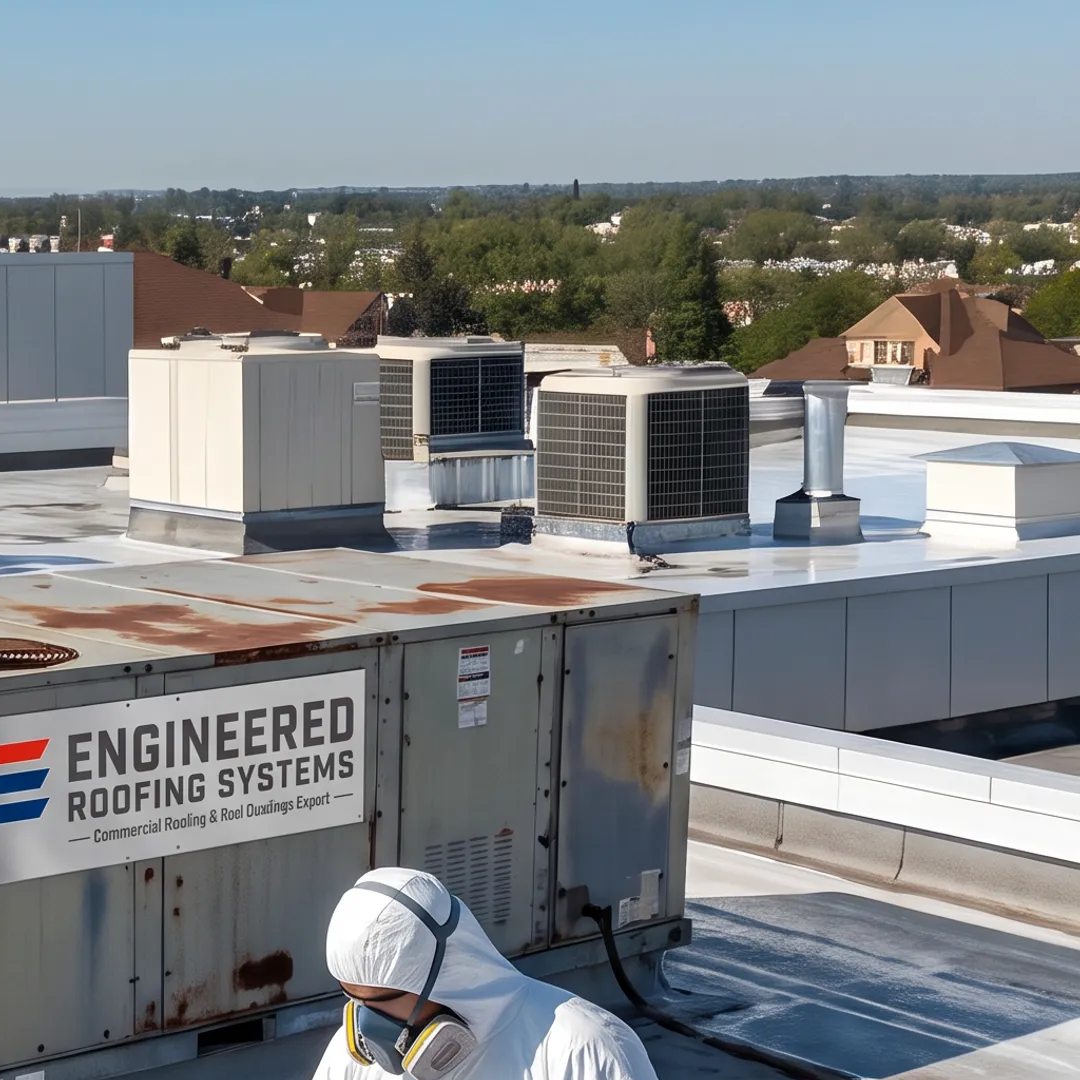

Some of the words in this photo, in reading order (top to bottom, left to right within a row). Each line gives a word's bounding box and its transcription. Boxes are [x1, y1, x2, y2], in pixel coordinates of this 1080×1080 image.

[68, 697, 354, 783] ENGINEERED
[68, 773, 205, 822] ROOFING
[218, 750, 354, 798] SYSTEMS
[94, 819, 162, 843] Commercial
[209, 809, 218, 823] &
[221, 804, 244, 821] Roel
[296, 792, 330, 810] Export
